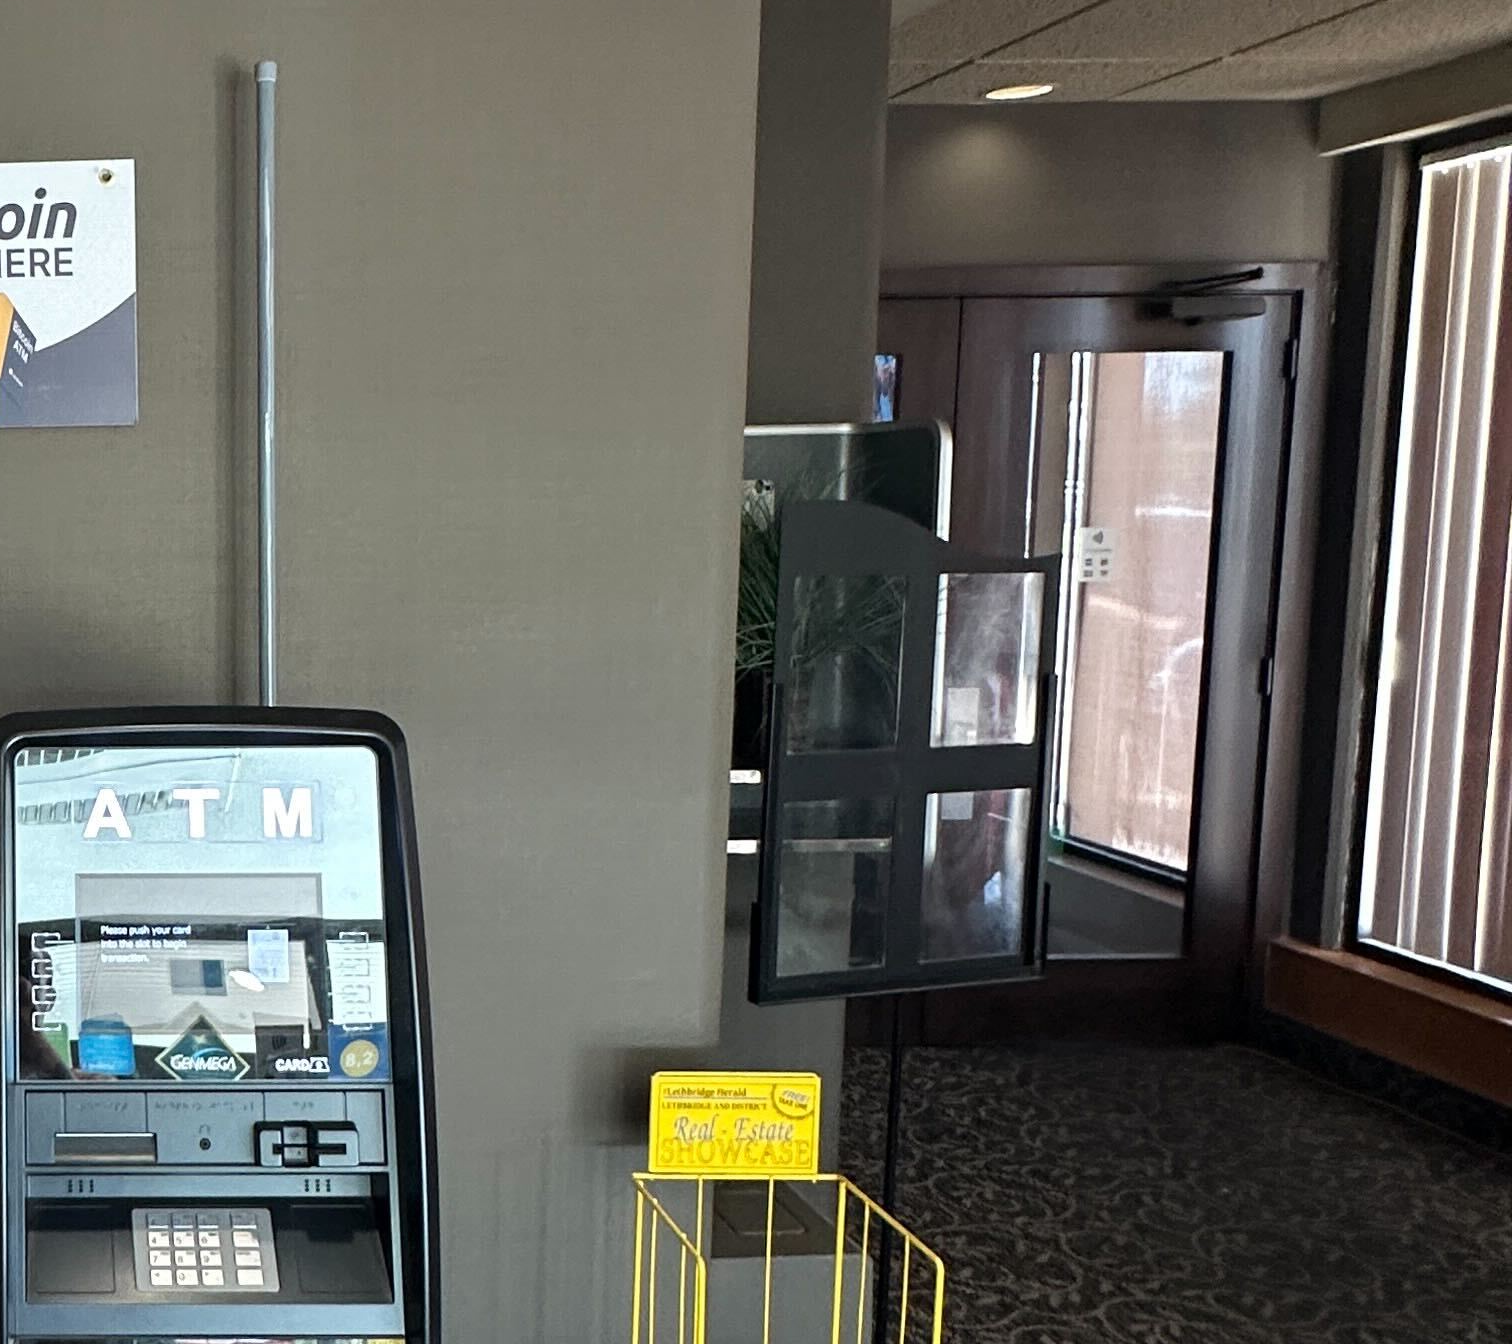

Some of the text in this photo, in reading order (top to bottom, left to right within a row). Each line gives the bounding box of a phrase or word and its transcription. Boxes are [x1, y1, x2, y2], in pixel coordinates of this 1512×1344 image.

[100, 925, 191, 937] Please push your card
[119, 940, 133, 948] the
[152, 940, 162, 948] to
[170, 1055, 237, 1073] GENMEGA
[667, 1087, 747, 1099] Lethbridge Herald
[662, 1102, 711, 1110] LETHBRIDGE
[674, 1114, 719, 1144] Real
[735, 1117, 794, 1143] Estate
[660, 1138, 810, 1166] SHOWCASE
